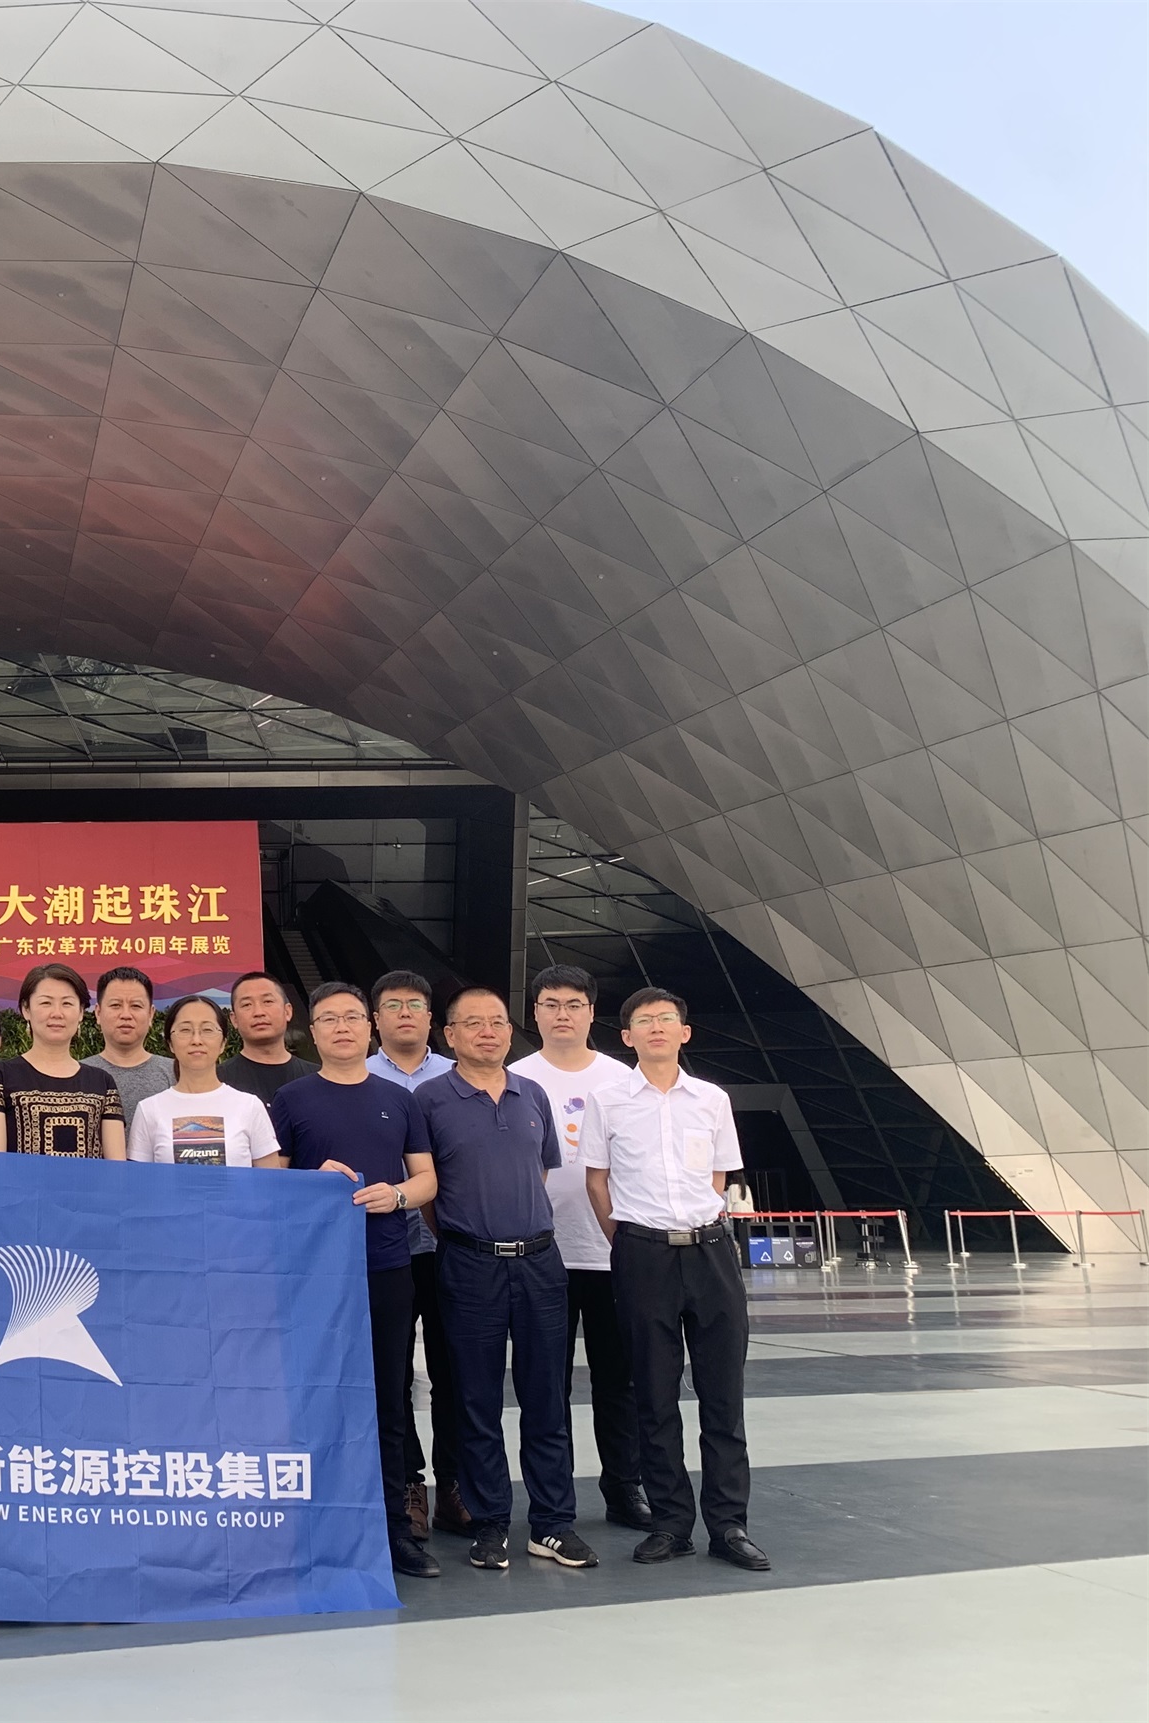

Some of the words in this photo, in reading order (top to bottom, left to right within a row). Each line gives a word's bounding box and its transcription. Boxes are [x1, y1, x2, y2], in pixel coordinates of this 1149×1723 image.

[18, 1504, 103, 1526] ENERGY
[110, 1508, 210, 1528] HOLDING
[216, 1511, 287, 1529] GROUP
